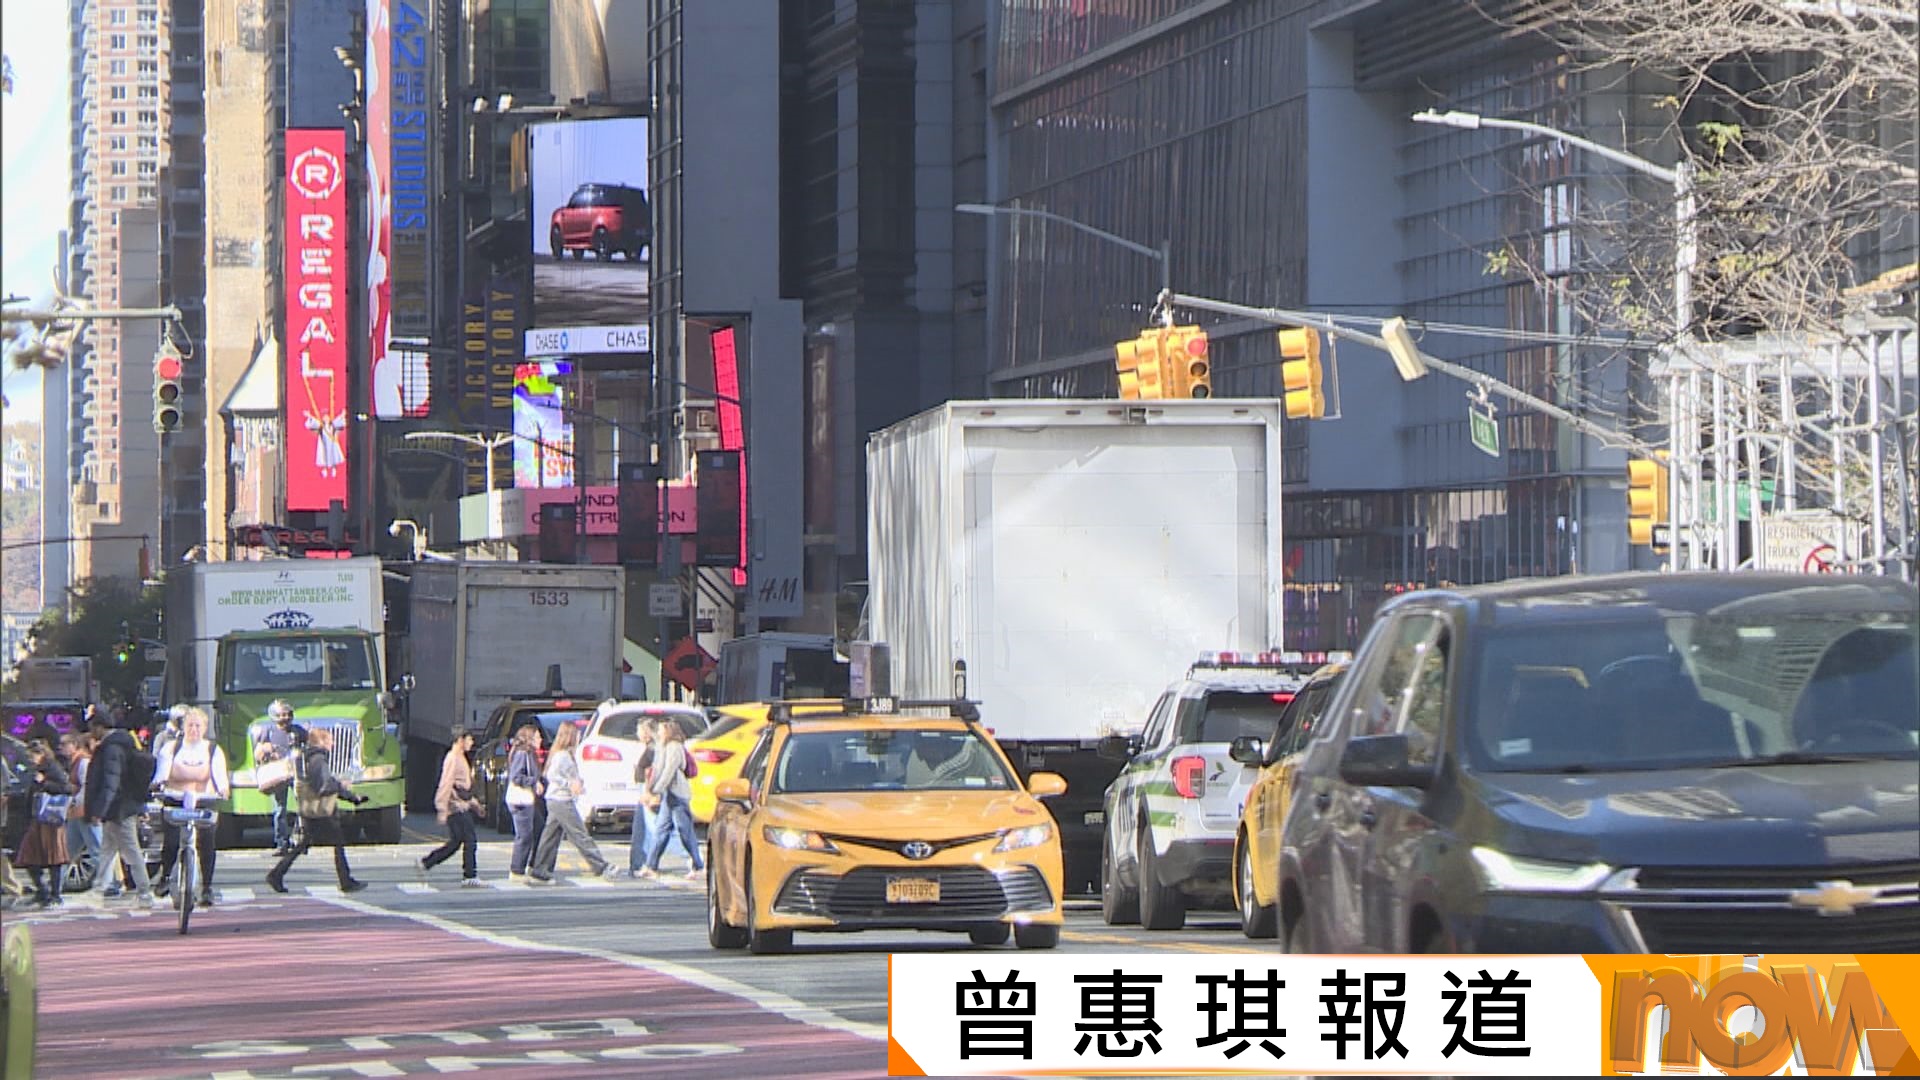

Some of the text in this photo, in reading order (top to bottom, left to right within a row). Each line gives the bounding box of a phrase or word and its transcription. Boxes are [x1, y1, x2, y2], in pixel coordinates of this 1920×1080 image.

[392, 2, 425, 67] 42
[392, 110, 426, 229] STUDIOS
[298, 213, 336, 378] REGAL
[464, 303, 487, 398] ICTORY
[491, 290, 515, 408] VICTORY
[536, 333, 559, 350] CHASE
[275, 530, 359, 544] REGL
[1768, 546, 1800, 558] TRUCKS
[529, 592, 569, 606] 1533
